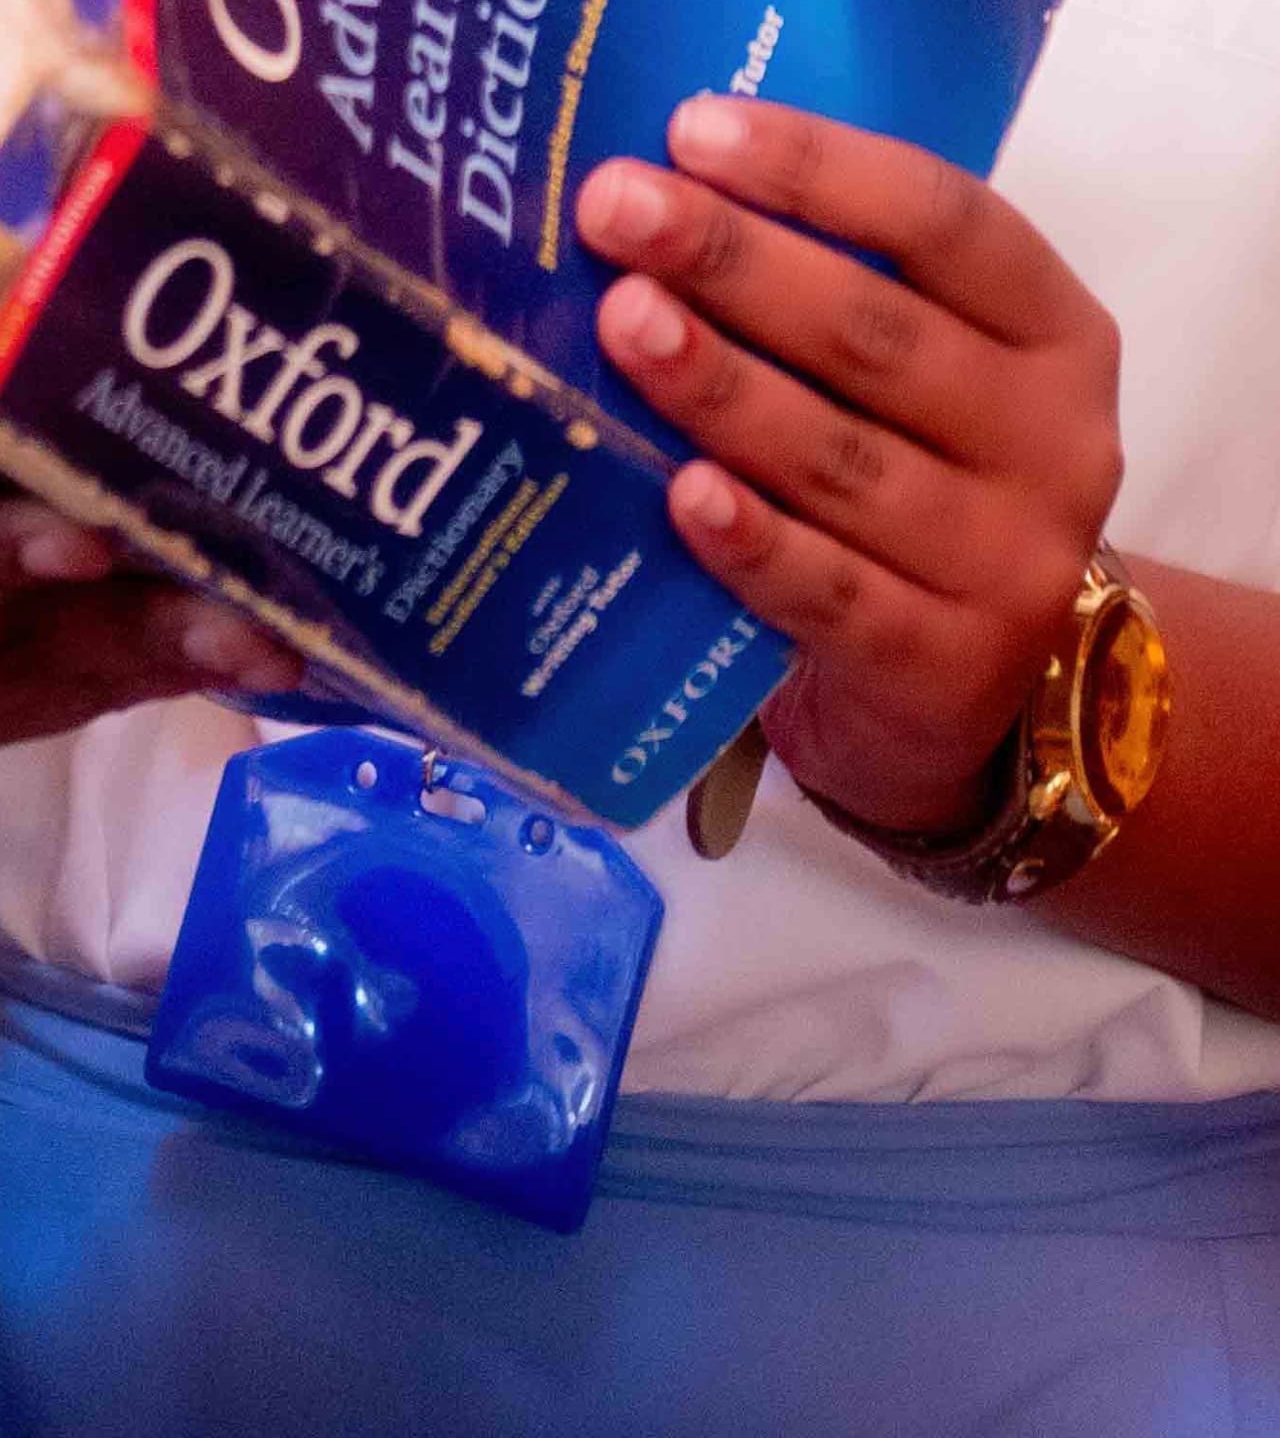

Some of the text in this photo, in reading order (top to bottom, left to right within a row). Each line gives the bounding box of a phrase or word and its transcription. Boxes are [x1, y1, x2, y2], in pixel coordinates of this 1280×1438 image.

[730, 5, 783, 97] Tutor
[76, 368, 386, 595] Advanced Learner's
[123, 237, 483, 536] Oxford
[384, 438, 524, 623] Dictionary
